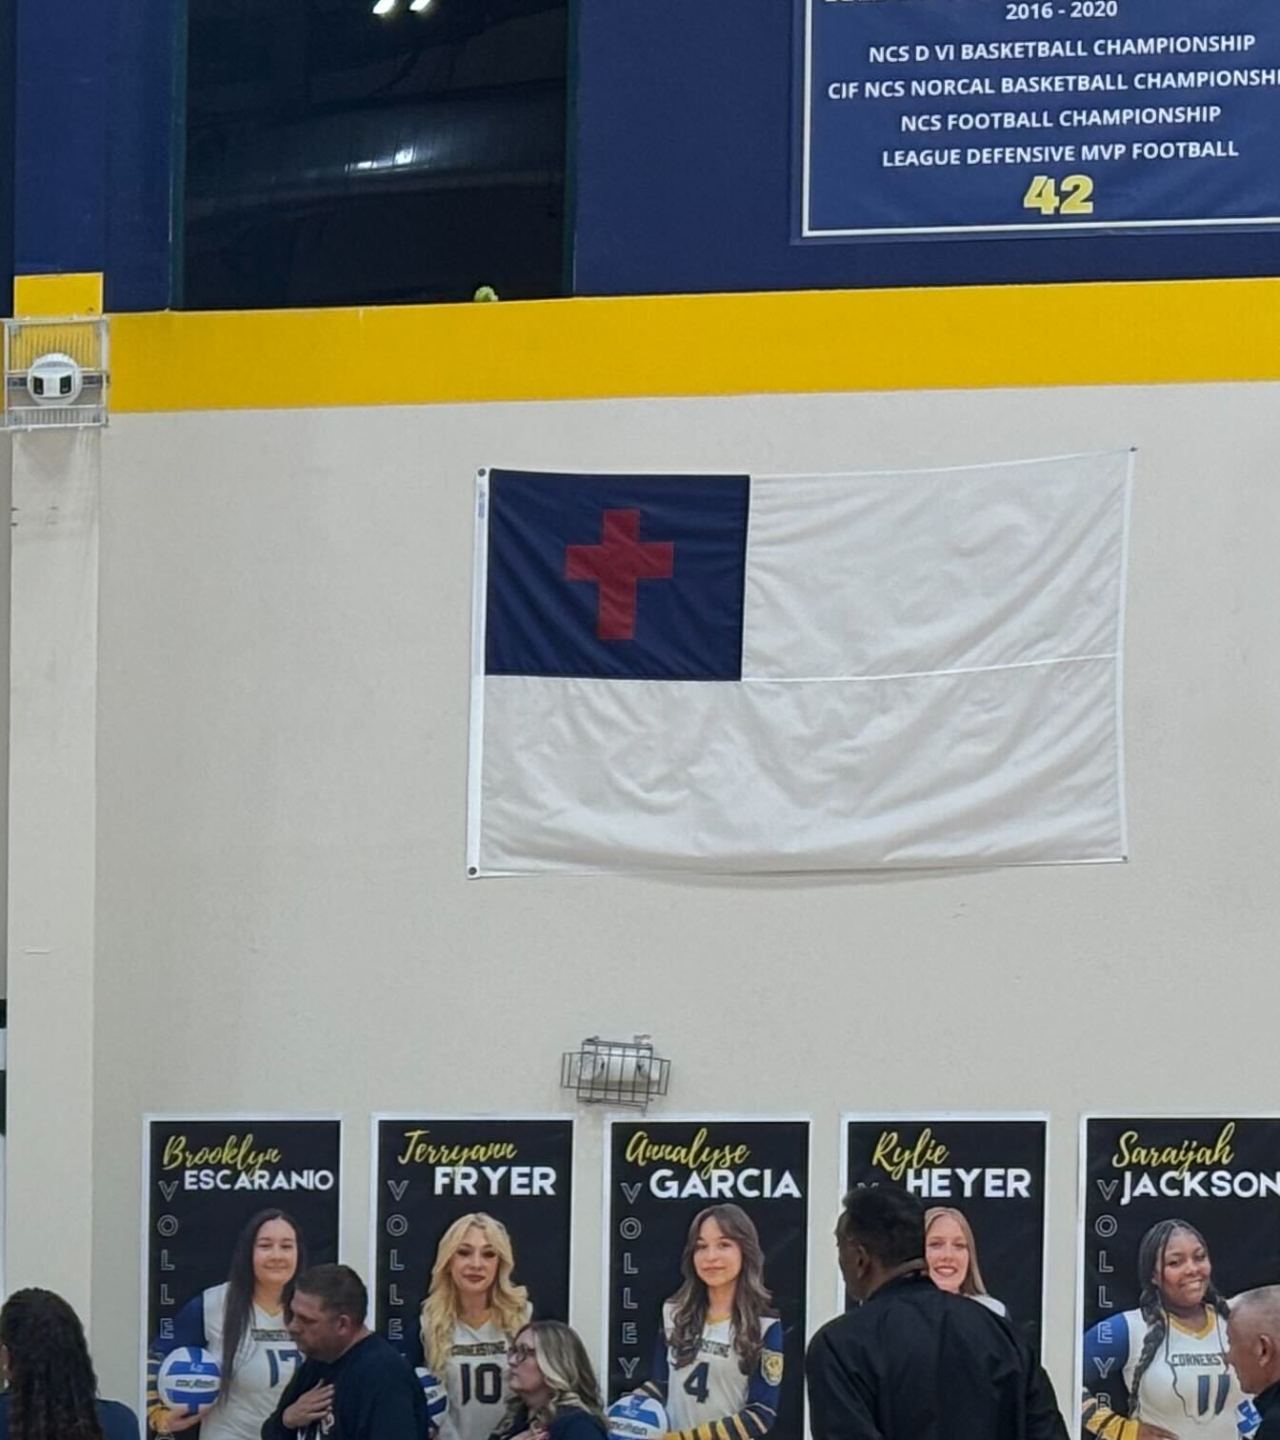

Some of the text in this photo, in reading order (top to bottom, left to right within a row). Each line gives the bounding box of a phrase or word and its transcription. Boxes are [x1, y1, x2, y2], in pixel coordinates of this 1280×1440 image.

[1005, 3, 1053, 20] 2016
[1070, 1, 1118, 19] 2020
[869, 34, 1256, 64] NCS D VI BASKETBALL CHAMPIONSHIP
[828, 69, 1280, 100] CIF NCS NORCAL BASKETBALL CHAMPIONSHI
[901, 105, 1222, 132] NCS FOOTBALL CHAMPIONSHIP
[882, 140, 1240, 168] LEAGUE DEFENSIVE MVP FOOTBALL
[1022, 174, 1095, 215] 42
[162, 1133, 282, 1181] Brooklyn
[396, 1129, 518, 1174] Terryann
[624, 1127, 752, 1179] Annalyse
[872, 1128, 950, 1180] Rylie
[183, 1168, 335, 1192] ESCARANIO
[434, 1166, 558, 1197] FRYER
[649, 1168, 802, 1199] GARCIA
[906, 1168, 1032, 1198] HEYER
[1119, 1170, 1280, 1206] JACKSON
[460, 1363, 503, 1406] 10
[683, 1361, 710, 1404] 4
